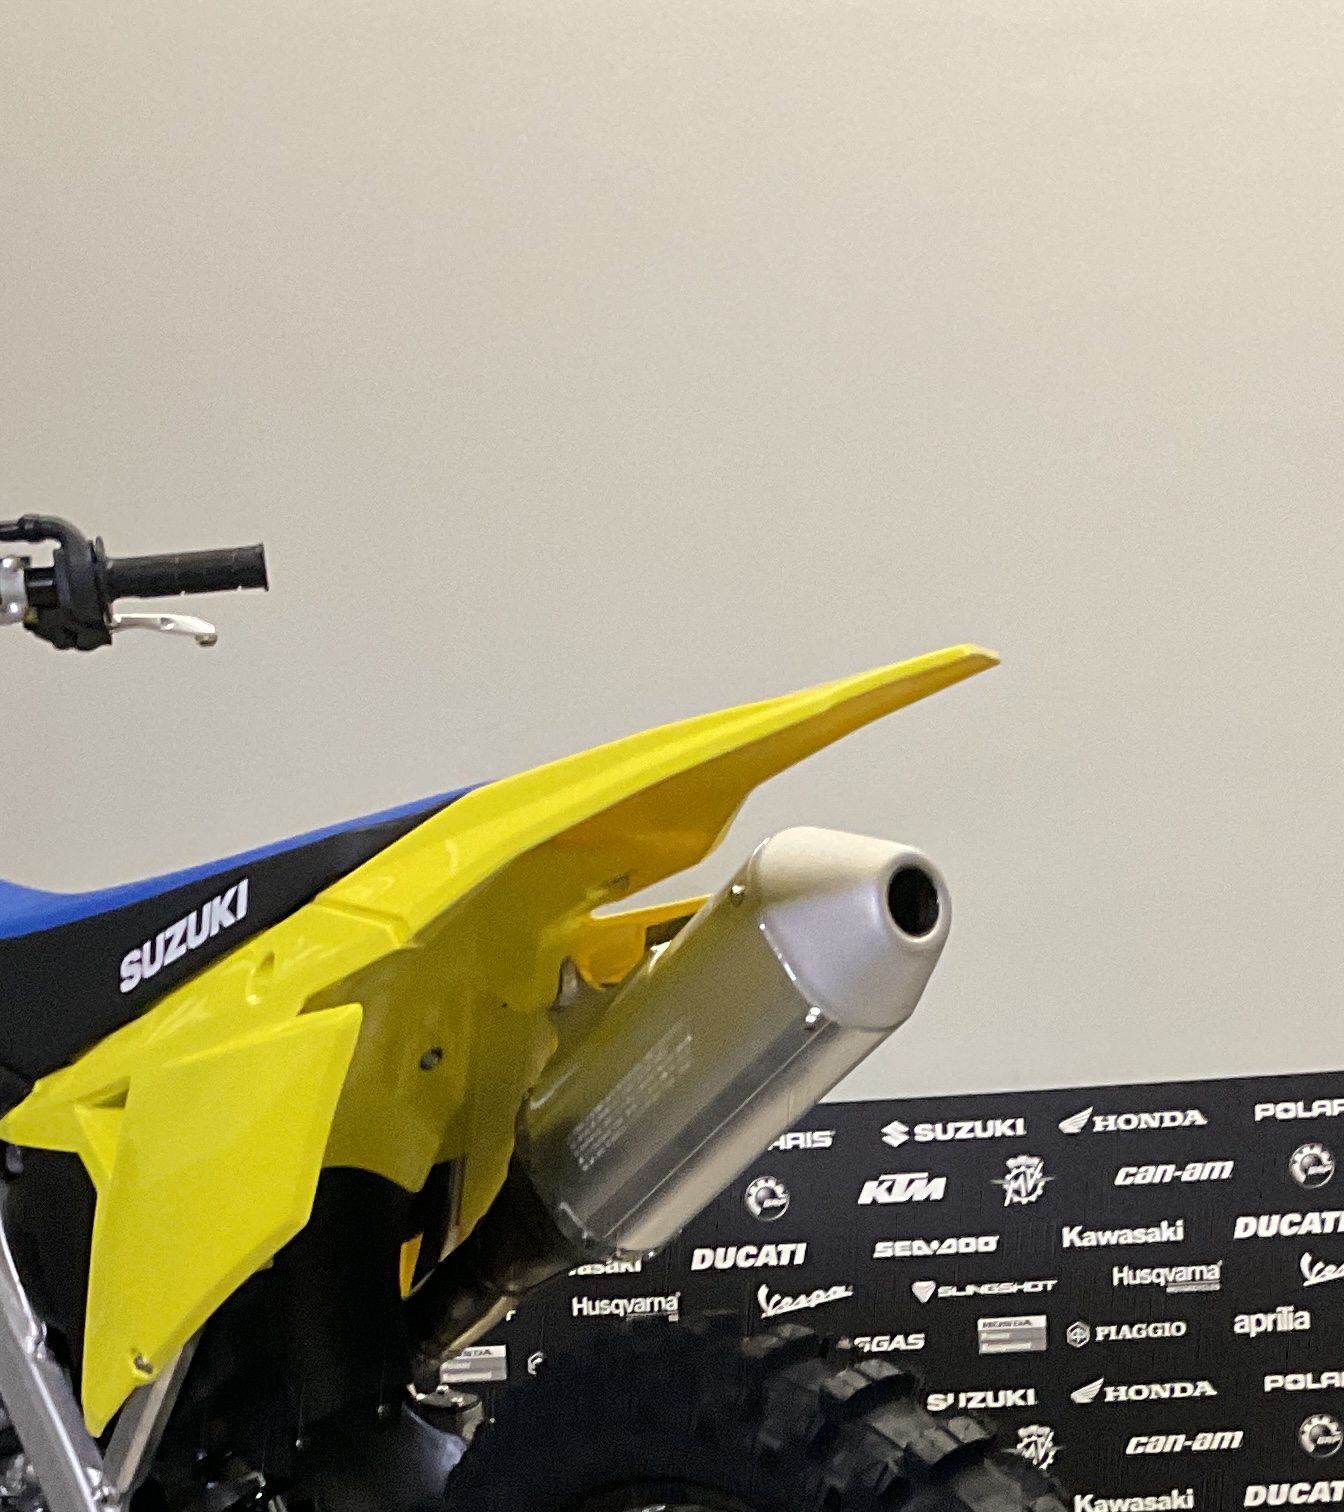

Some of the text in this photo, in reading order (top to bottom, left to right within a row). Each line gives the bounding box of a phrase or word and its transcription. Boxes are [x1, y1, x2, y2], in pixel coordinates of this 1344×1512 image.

[119, 878, 249, 994] SUZUKI
[914, 1118, 1026, 1141] SUZUKI
[1093, 1110, 1208, 1132] HONDA
[858, 1172, 946, 1204] KTM
[1062, 1220, 1184, 1247] Kawasaki
[691, 1243, 806, 1270] DUCATI
[1113, 1260, 1222, 1286] Husqvarna
[572, 1292, 680, 1315] Husqvarna
[1096, 1322, 1186, 1341] PIAGGIO
[1234, 1306, 1310, 1337] aprilia
[1104, 1381, 1217, 1402] HONDA
